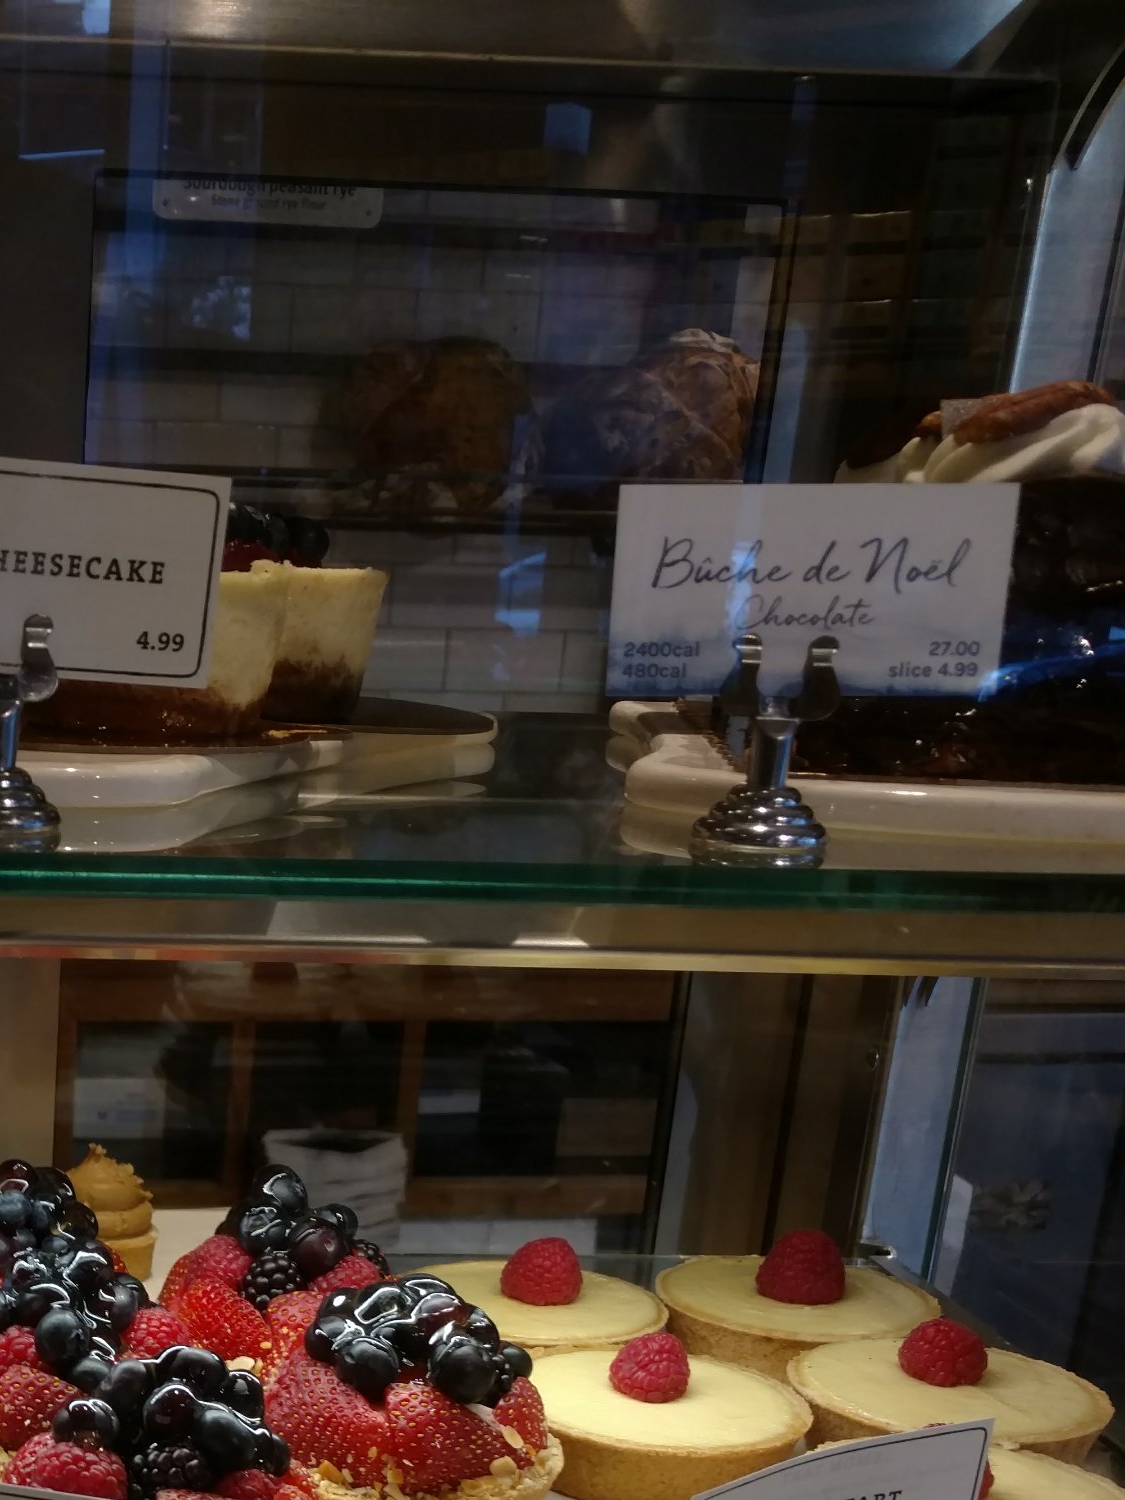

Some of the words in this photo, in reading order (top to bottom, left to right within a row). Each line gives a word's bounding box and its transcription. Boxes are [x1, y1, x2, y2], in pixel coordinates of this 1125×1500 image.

[651, 536, 793, 589] Bûche
[802, 541, 851, 585] de
[860, 536, 972, 594] Noël
[734, 593, 875, 631] Chocolate
[136, 631, 185, 653] 4.99
[623, 641, 700, 658] 2400cal
[928, 641, 980, 657] 27.00
[622, 663, 687, 679] 480cal
[888, 662, 931, 679] slice
[938, 662, 978, 678] 4.99
